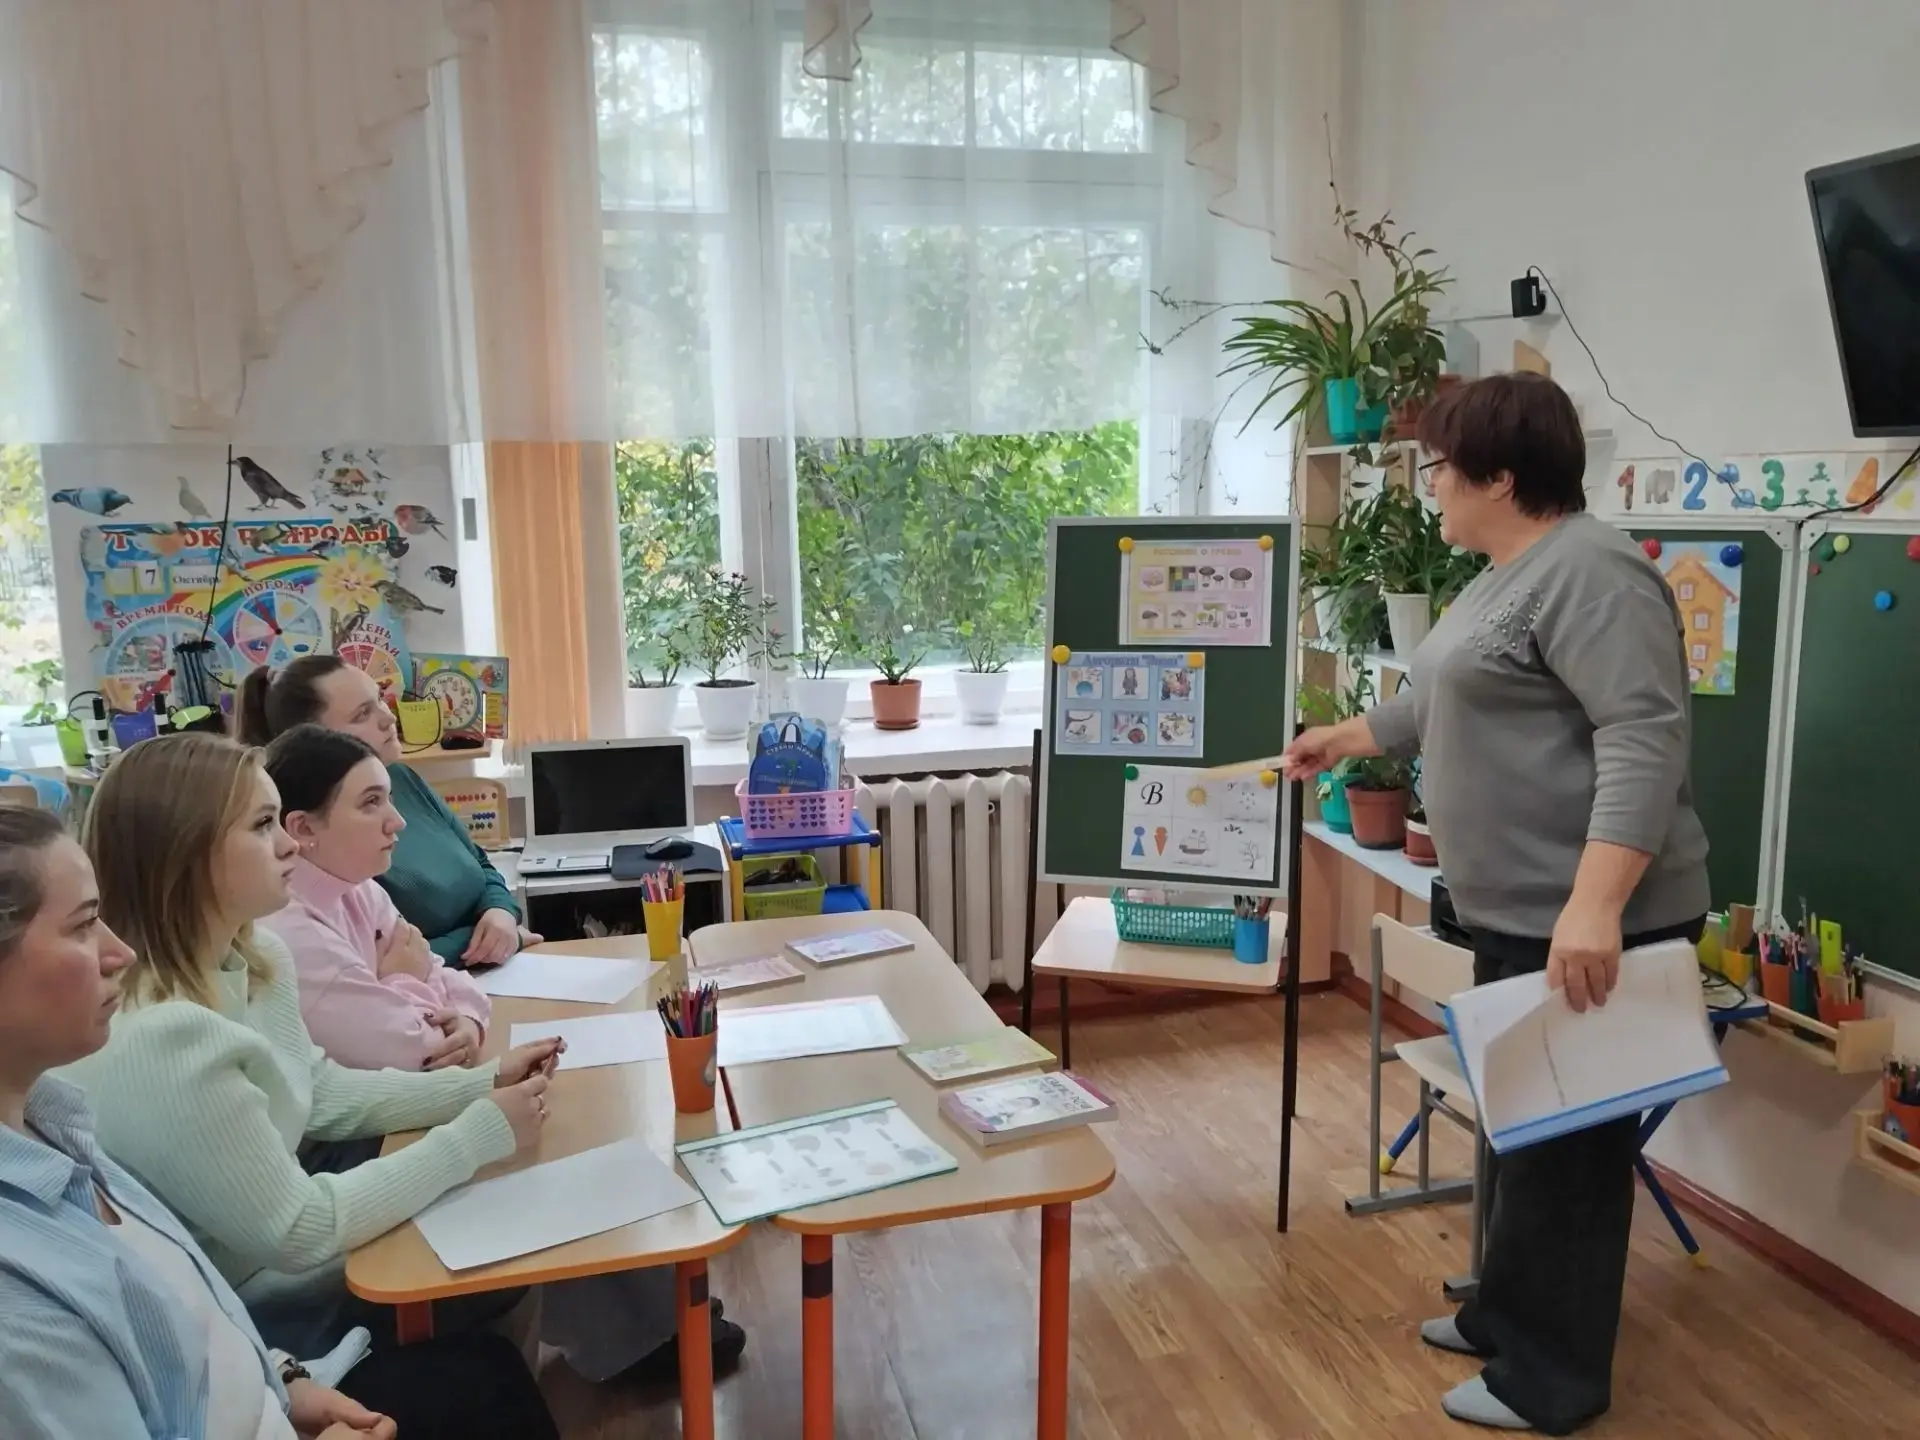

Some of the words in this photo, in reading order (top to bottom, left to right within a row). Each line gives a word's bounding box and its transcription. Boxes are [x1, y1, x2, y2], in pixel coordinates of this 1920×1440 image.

[1682, 462, 1709, 511] 2
[1760, 459, 1785, 512] 3
[145, 568, 156, 585] 7
